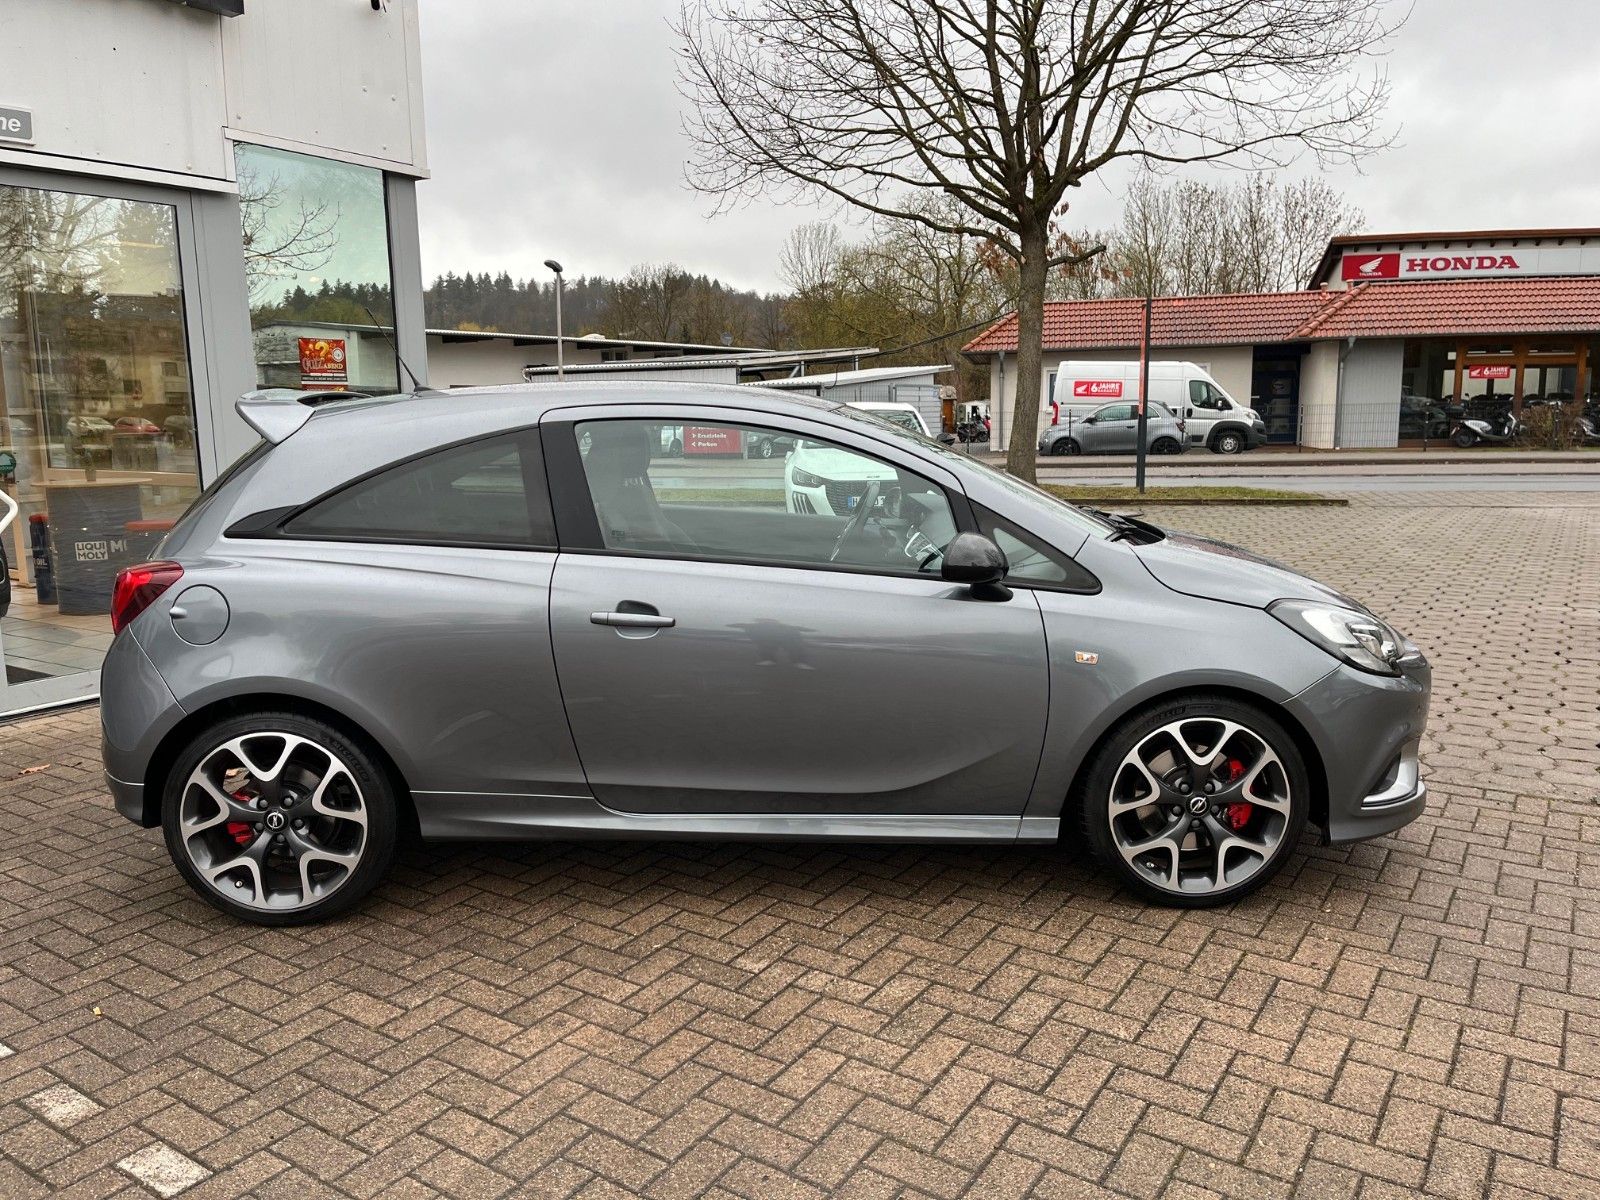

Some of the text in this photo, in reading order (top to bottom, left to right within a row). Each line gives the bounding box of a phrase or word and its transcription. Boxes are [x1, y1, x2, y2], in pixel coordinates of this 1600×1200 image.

[1405, 255, 1520, 272] HONDA
[1483, 366, 1490, 376] 6
[1090, 383, 1098, 393] 6
[76, 542, 106, 551] LIQUI
[77, 551, 106, 560] MOLY
